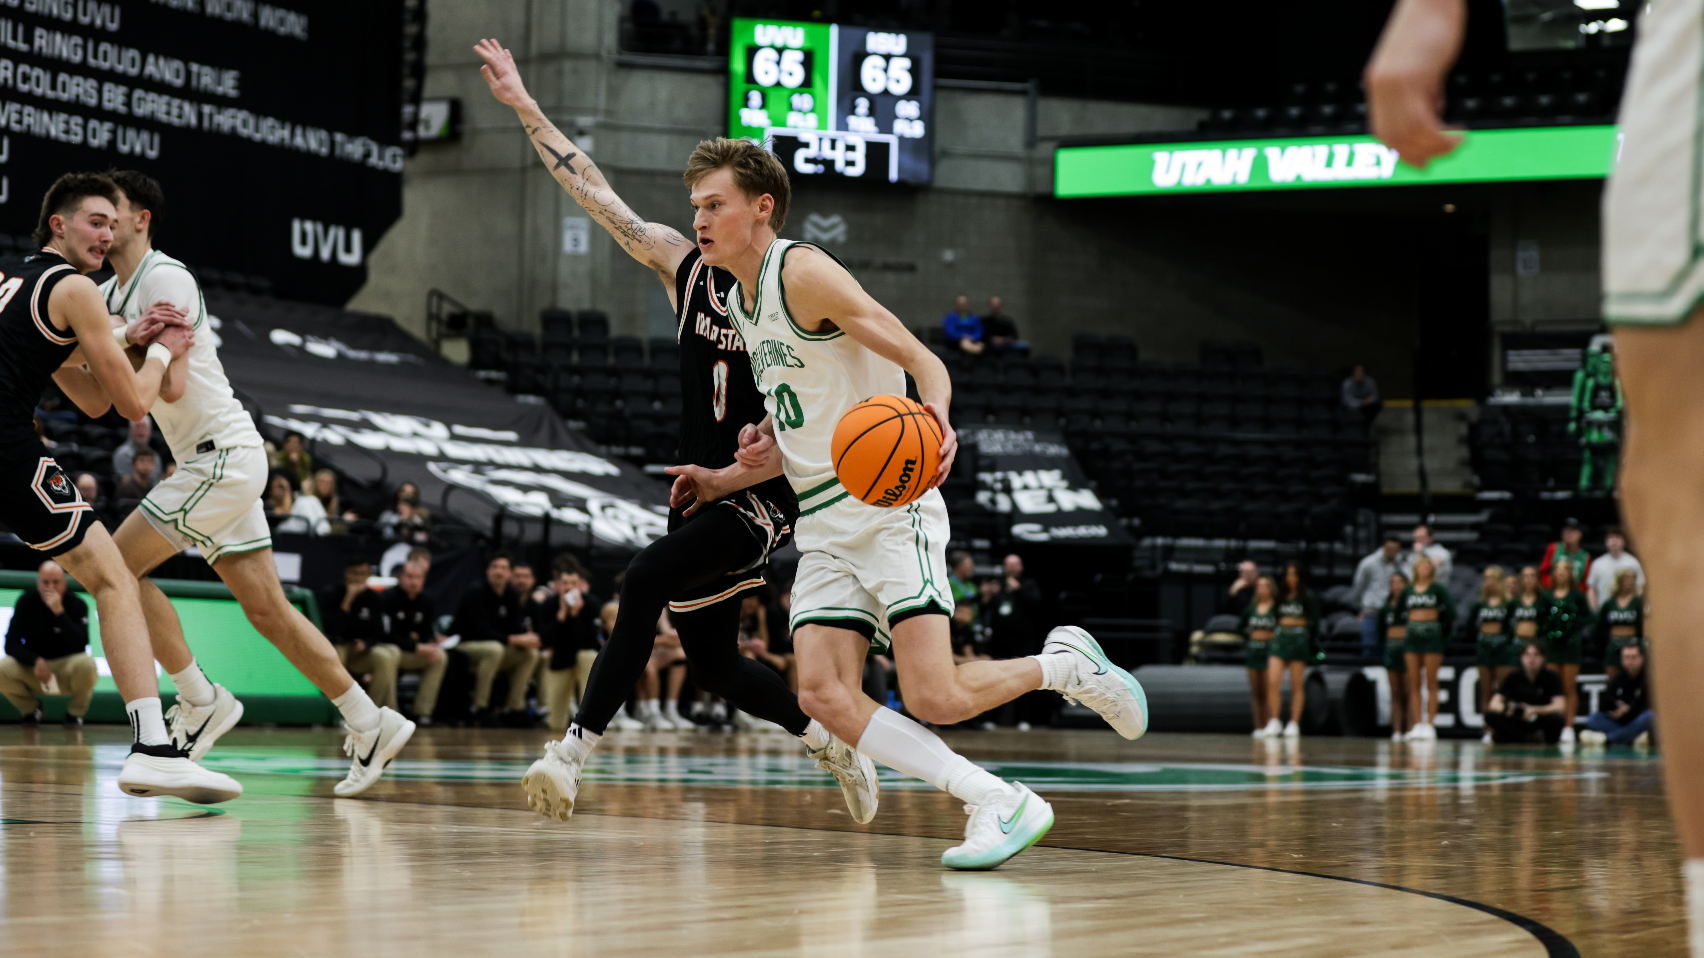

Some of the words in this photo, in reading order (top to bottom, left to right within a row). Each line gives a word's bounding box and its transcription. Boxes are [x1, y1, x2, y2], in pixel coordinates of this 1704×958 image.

[753, 23, 805, 49] UVU
[33, 26, 84, 65] RING
[86, 37, 142, 77] LOUD
[142, 52, 186, 88] AND
[187, 61, 241, 98] TRUE
[753, 47, 805, 88] 65
[860, 55, 913, 96] 65
[16, 63, 99, 108] COLORS
[101, 81, 130, 115] BE
[131, 88, 199, 129] GREEN
[292, 123, 331, 158] AND
[86, 117, 115, 150] OF
[116, 123, 161, 160] UVU
[793, 131, 867, 178] 2:43
[1151, 147, 1258, 188] UTAH
[1263, 142, 1400, 184] VALLEY
[292, 217, 363, 267] UVU
